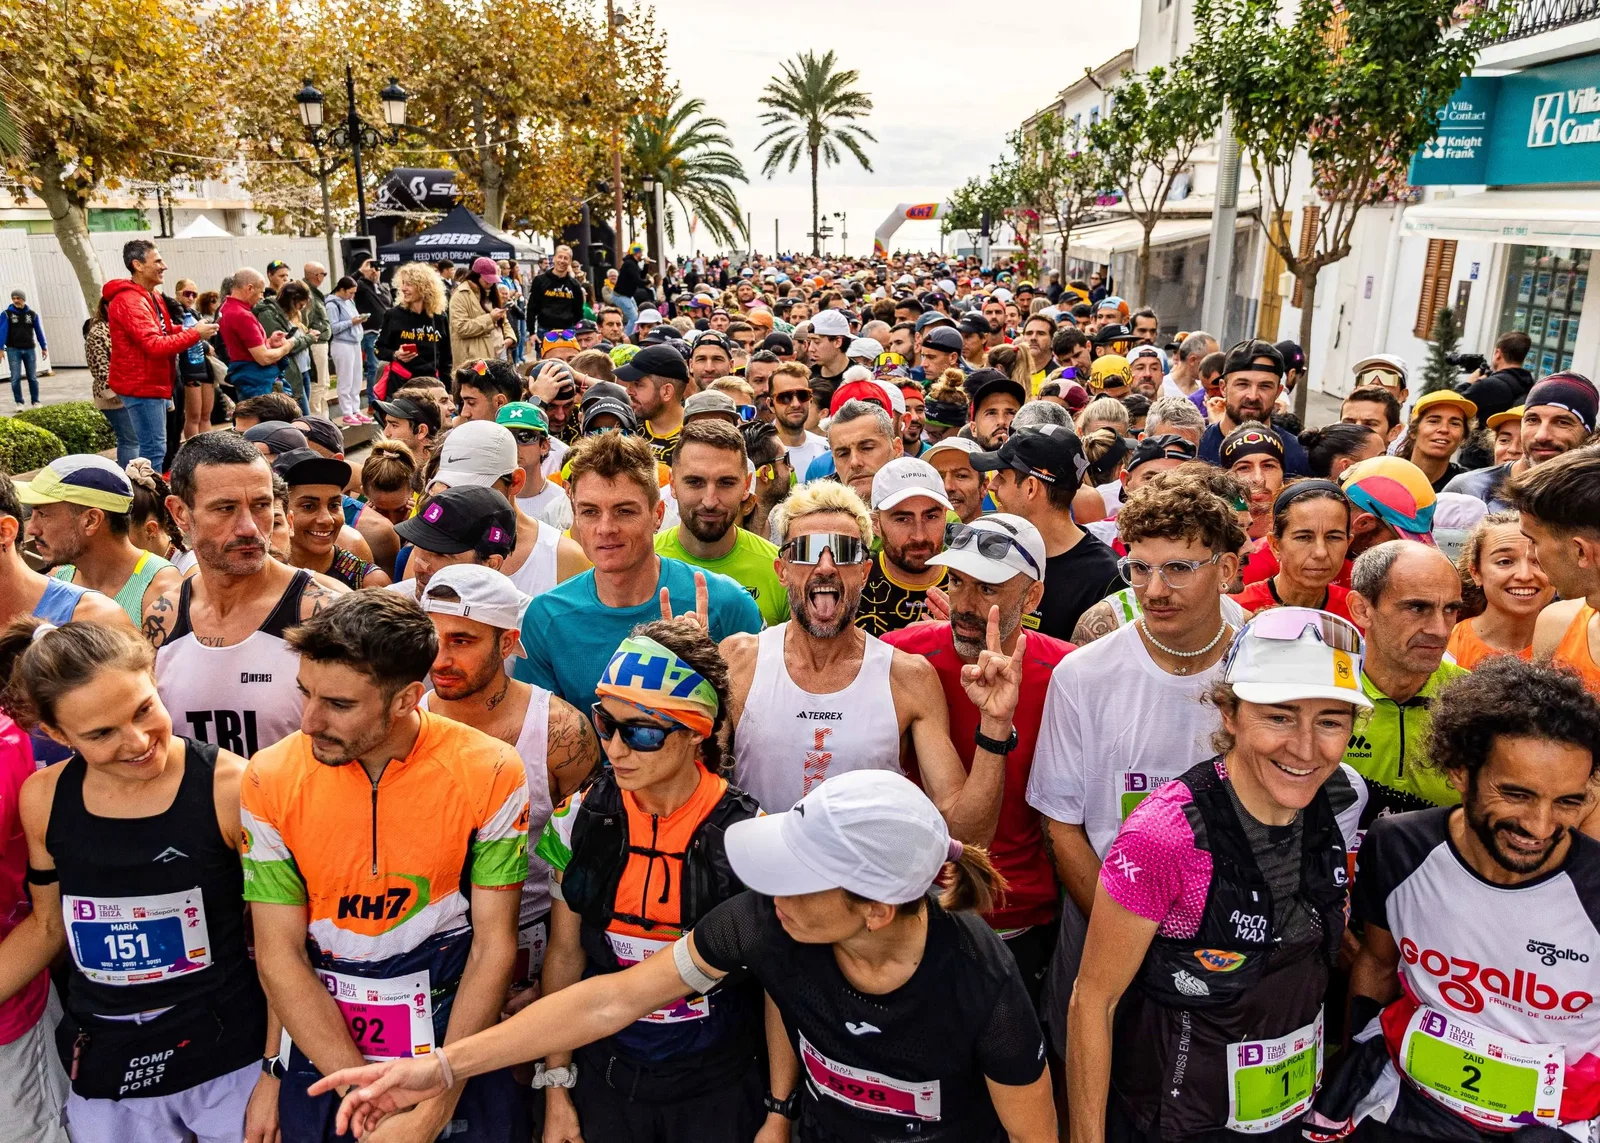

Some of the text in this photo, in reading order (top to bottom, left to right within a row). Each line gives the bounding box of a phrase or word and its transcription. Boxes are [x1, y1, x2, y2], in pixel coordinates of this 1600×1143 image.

[1451, 101, 1473, 111] Villa
[1449, 111, 1486, 121] Contact
[1560, 118, 1600, 145] Cont
[1447, 136, 1483, 148] Knight
[1446, 148, 1475, 159] Frank
[415, 232, 483, 246] 226ERS
[413, 251, 431, 261] FEED
[431, 250, 449, 261] YOUR
[1225, 431, 1284, 456] CROWN
[900, 472, 928, 480] KIPRUN
[808, 711, 843, 721] TERREX
[185, 709, 259, 760] TRI
[1347, 751, 1373, 759] mobel
[100, 910, 122, 918] IBIZA
[146, 907, 181, 917] Trideporte
[110, 922, 139, 932] MARÍA
[1234, 924, 1266, 943] MAX
[103, 932, 150, 961] 151
[340, 980, 358, 991] TRAIL
[340, 988, 358, 999] IBIZA
[378, 993, 411, 1002] Trideporte
[1488, 996, 1523, 1013] FRUITES
[1527, 1010, 1540, 1020] DE
[1450, 1023, 1476, 1041] TRAIL
[1449, 1032, 1475, 1048] IBIZA
[1266, 1043, 1287, 1053] TRAIL
[1267, 1049, 1287, 1060] IBIZA
[129, 1049, 175, 1068] COMP
[1265, 1052, 1306, 1075] NÚRIA PICAS
[1463, 1051, 1485, 1065] ZAID
[1503, 1053, 1541, 1065] Trideporte
[124, 1063, 166, 1082] RESS
[1172, 1053, 1188, 1085] SWISS
[119, 1074, 163, 1095] PORT
[1281, 1071, 1290, 1097] 1
[1460, 1065, 1482, 1093] 2
[829, 1075, 887, 1102] 598
[1460, 1090, 1479, 1102] 20002
